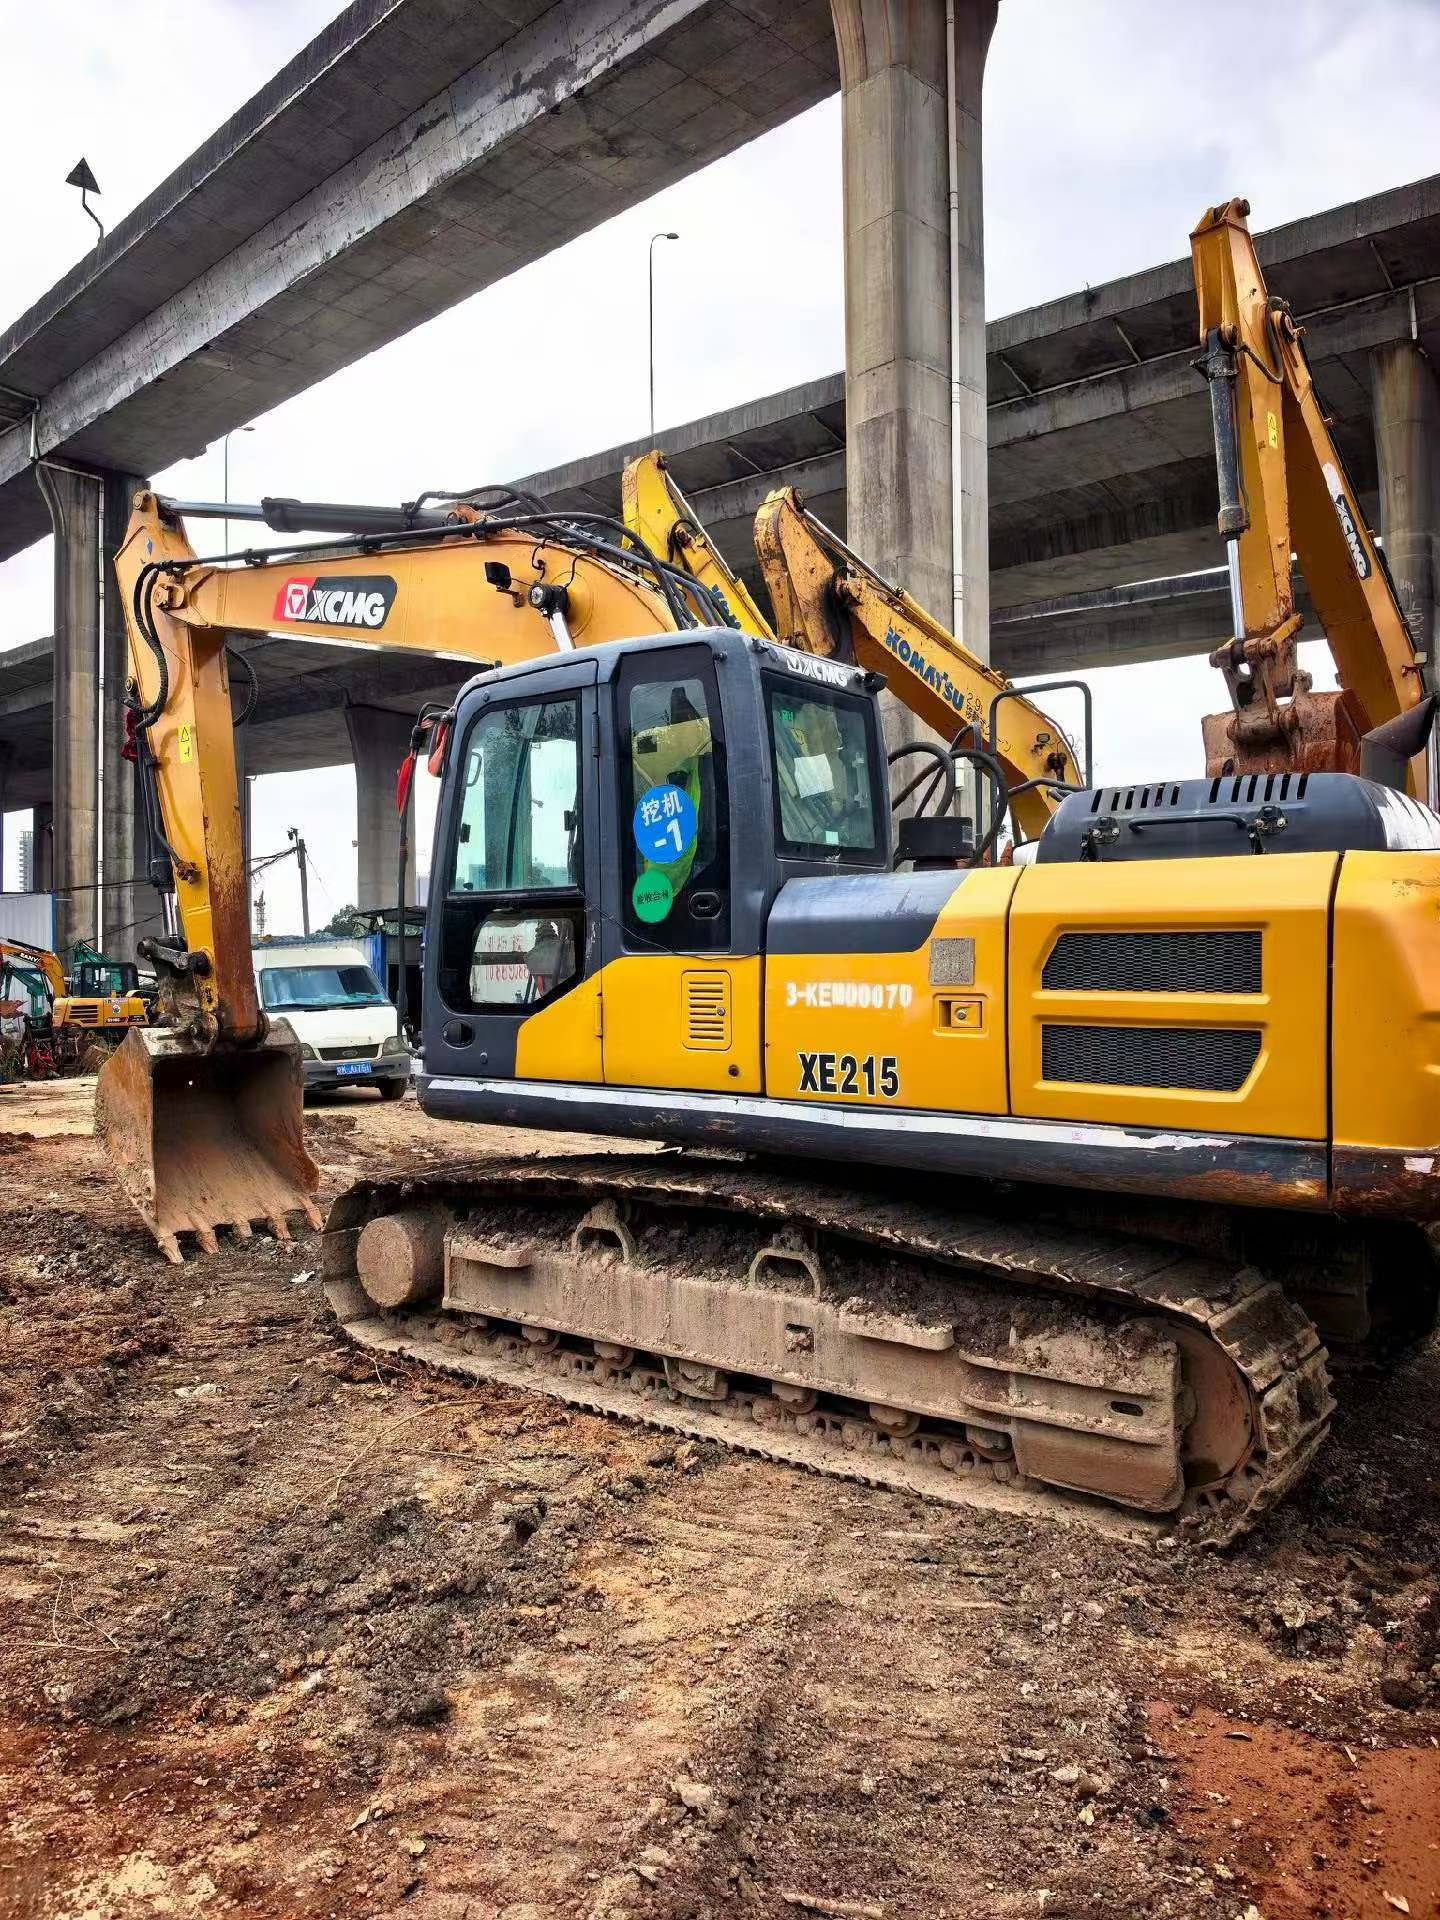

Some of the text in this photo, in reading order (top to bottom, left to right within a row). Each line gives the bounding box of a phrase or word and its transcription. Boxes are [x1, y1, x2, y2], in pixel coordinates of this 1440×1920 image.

[1335, 495, 1365, 577] XCMG
[305, 589, 385, 626] XCMG
[801, 660, 848, 687] XCMG
[884, 625, 966, 712] KOMATSU
[641, 789, 683, 827] 挖机
[654, 818, 683, 852] -1
[798, 1051, 900, 1098] XE215
